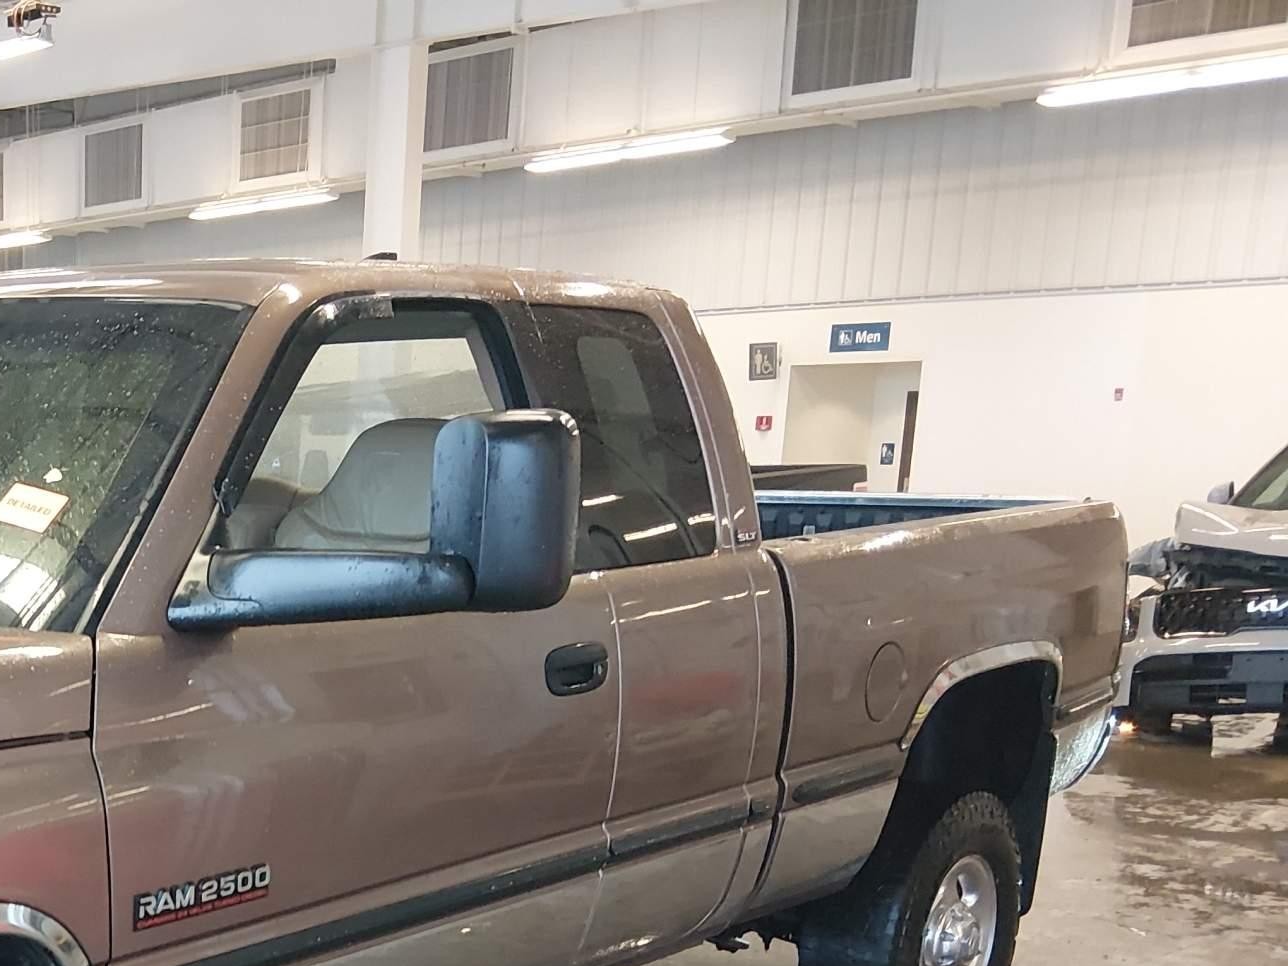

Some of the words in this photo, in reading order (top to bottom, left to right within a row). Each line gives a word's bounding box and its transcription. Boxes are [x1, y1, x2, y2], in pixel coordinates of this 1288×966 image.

[855, 330, 881, 344] Men
[737, 531, 756, 542] SLT
[138, 884, 195, 919] RAM
[201, 864, 271, 903] 2500
